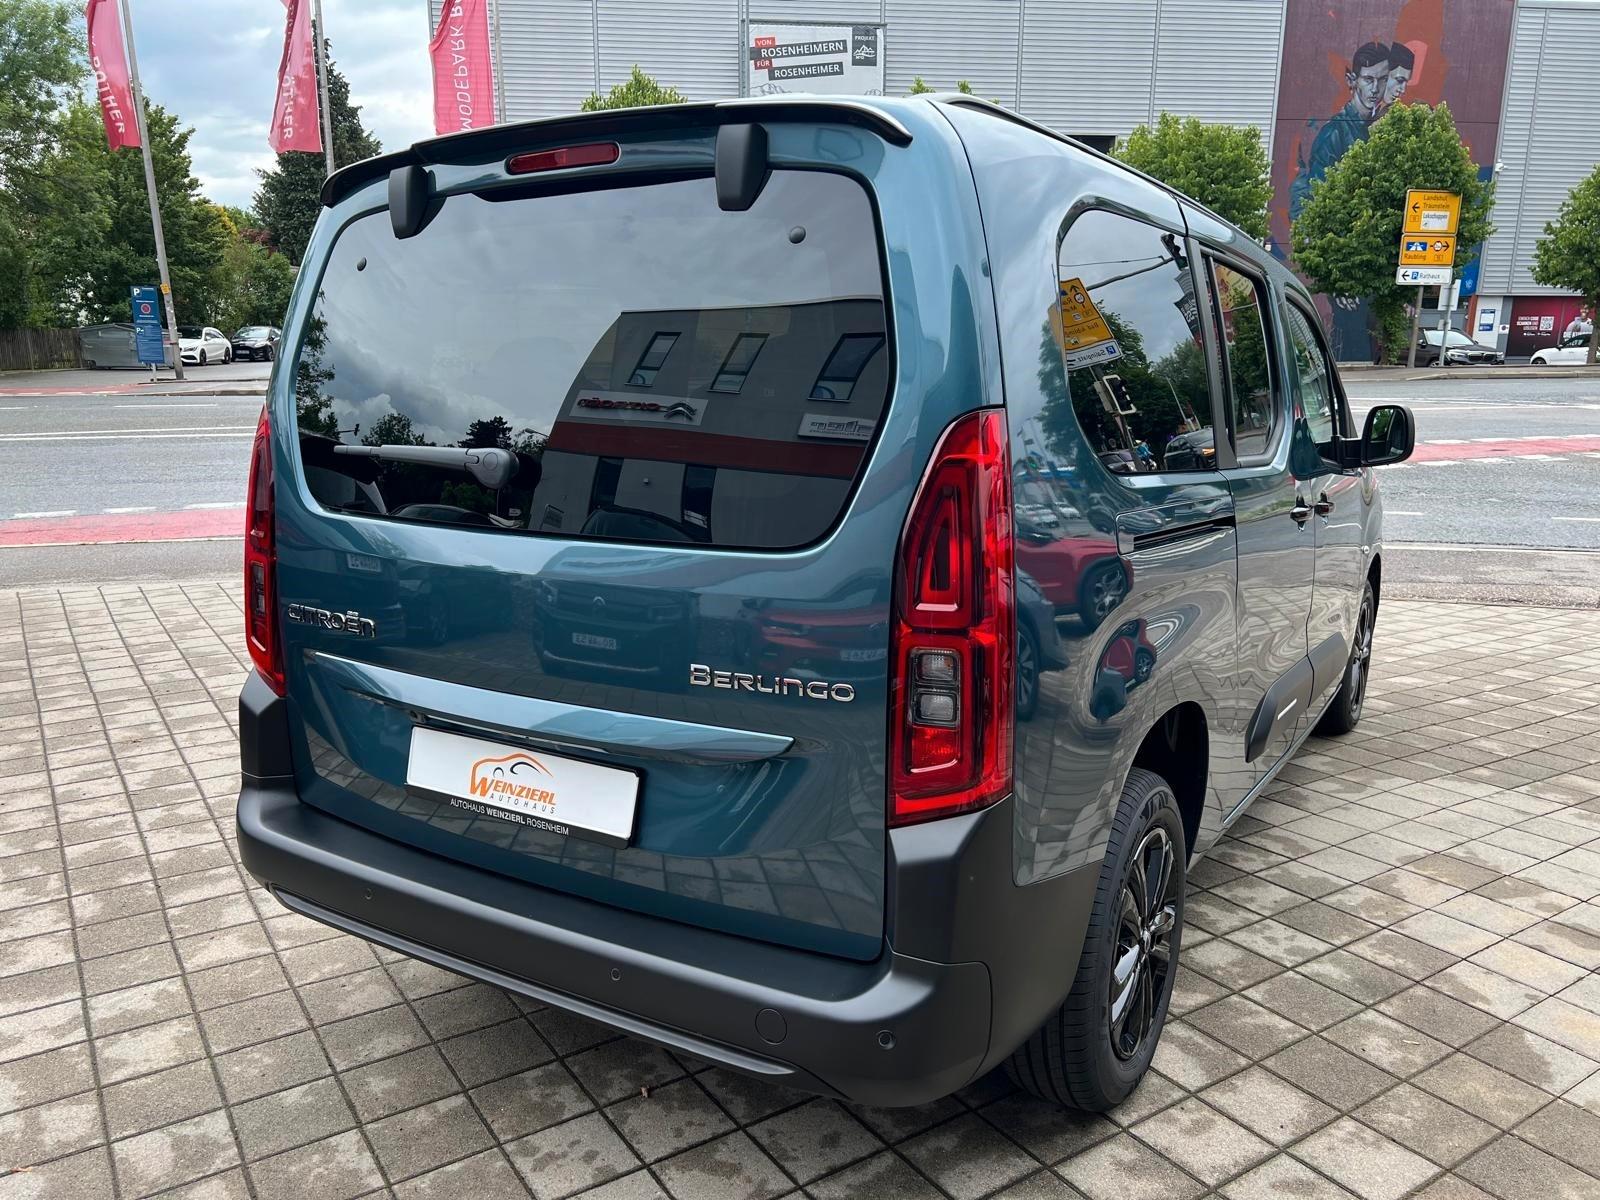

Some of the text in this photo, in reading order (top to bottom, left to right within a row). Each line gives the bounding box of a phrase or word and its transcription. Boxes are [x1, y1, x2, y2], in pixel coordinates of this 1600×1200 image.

[761, 42, 843, 58] ROSENHEIMERN
[756, 59, 770, 67] FÜR
[774, 64, 840, 78] ROSENHEIMER
[282, 63, 295, 140] ÖTHER
[469, 776, 557, 806] WEINZIERL
[489, 793, 556, 814] AUTOHAUS
[450, 798, 569, 836] AUTOHAUS WEINZIERL ROSENHEIM
